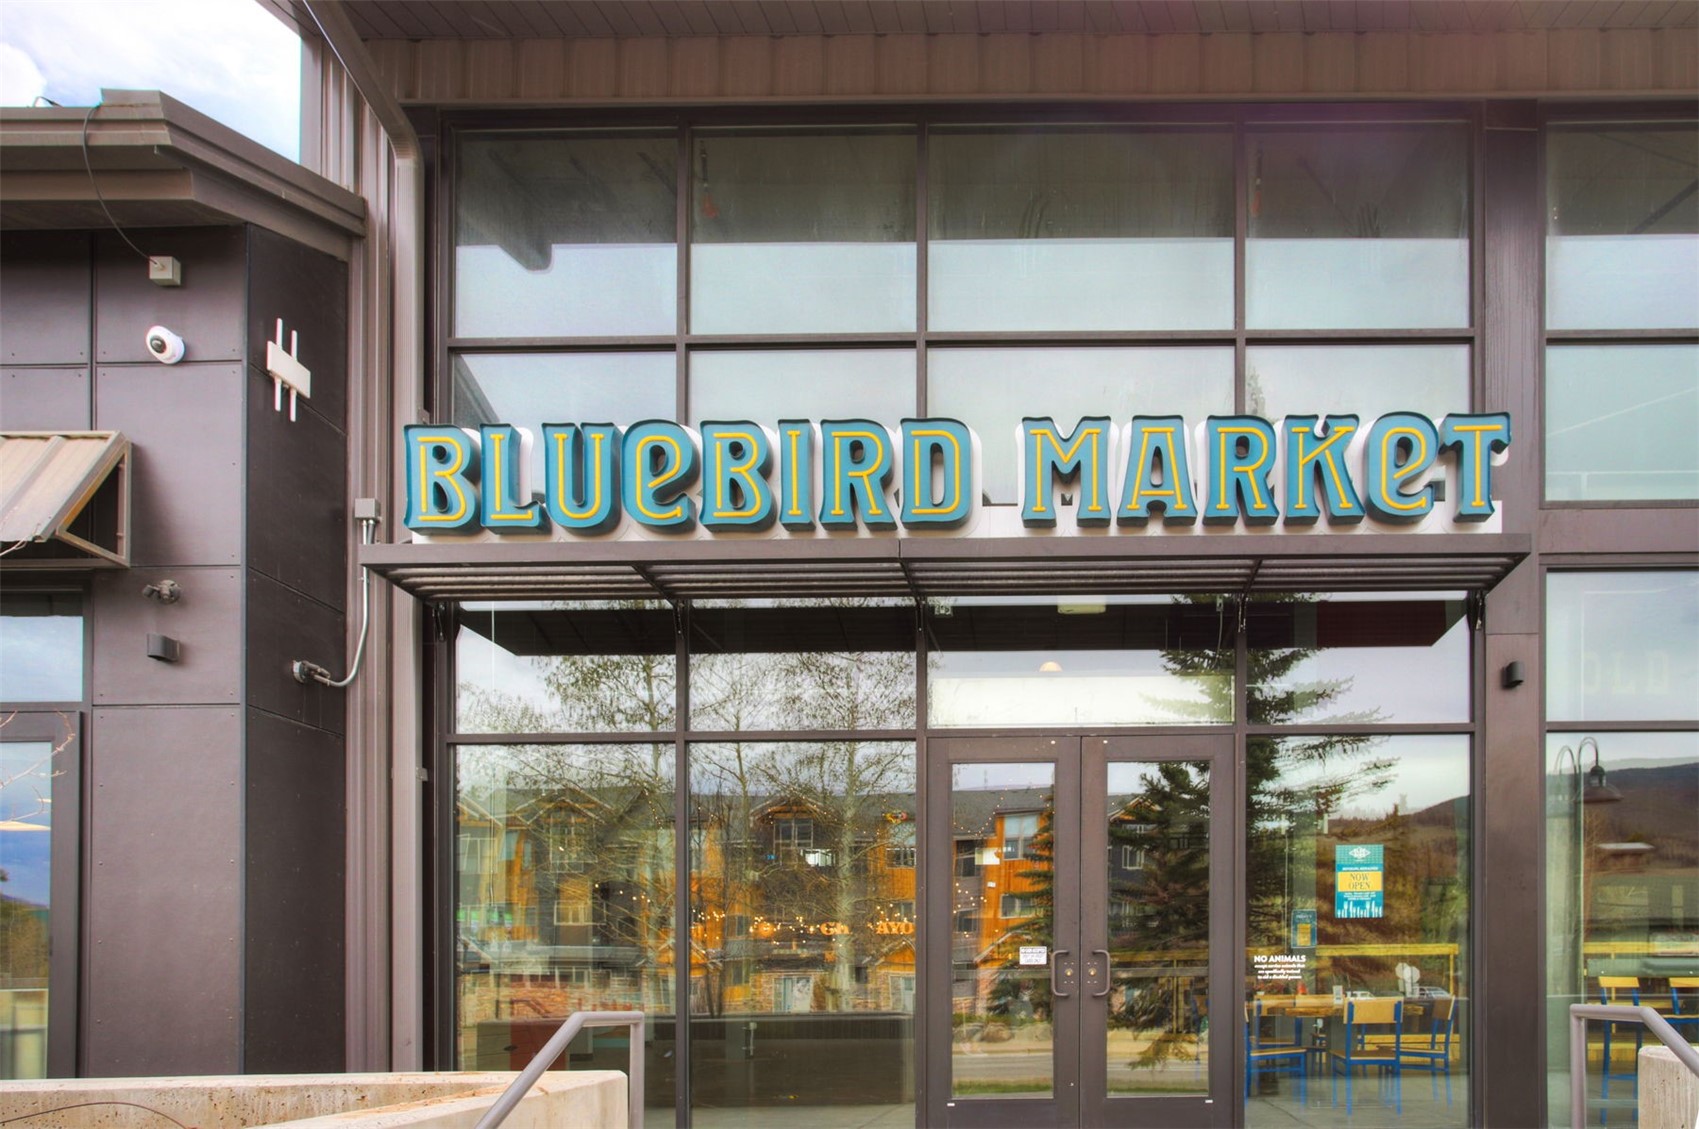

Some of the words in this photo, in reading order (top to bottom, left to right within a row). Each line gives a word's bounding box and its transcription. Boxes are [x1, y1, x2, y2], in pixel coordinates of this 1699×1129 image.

[404, 418, 974, 534] BLUEBIRD
[1020, 411, 1511, 528] MARKET
[1350, 873, 1370, 881] NOW
[1348, 881, 1371, 890] OPEN
[1253, 955, 1268, 963] NO
[1268, 955, 1307, 963] ANIMALS
